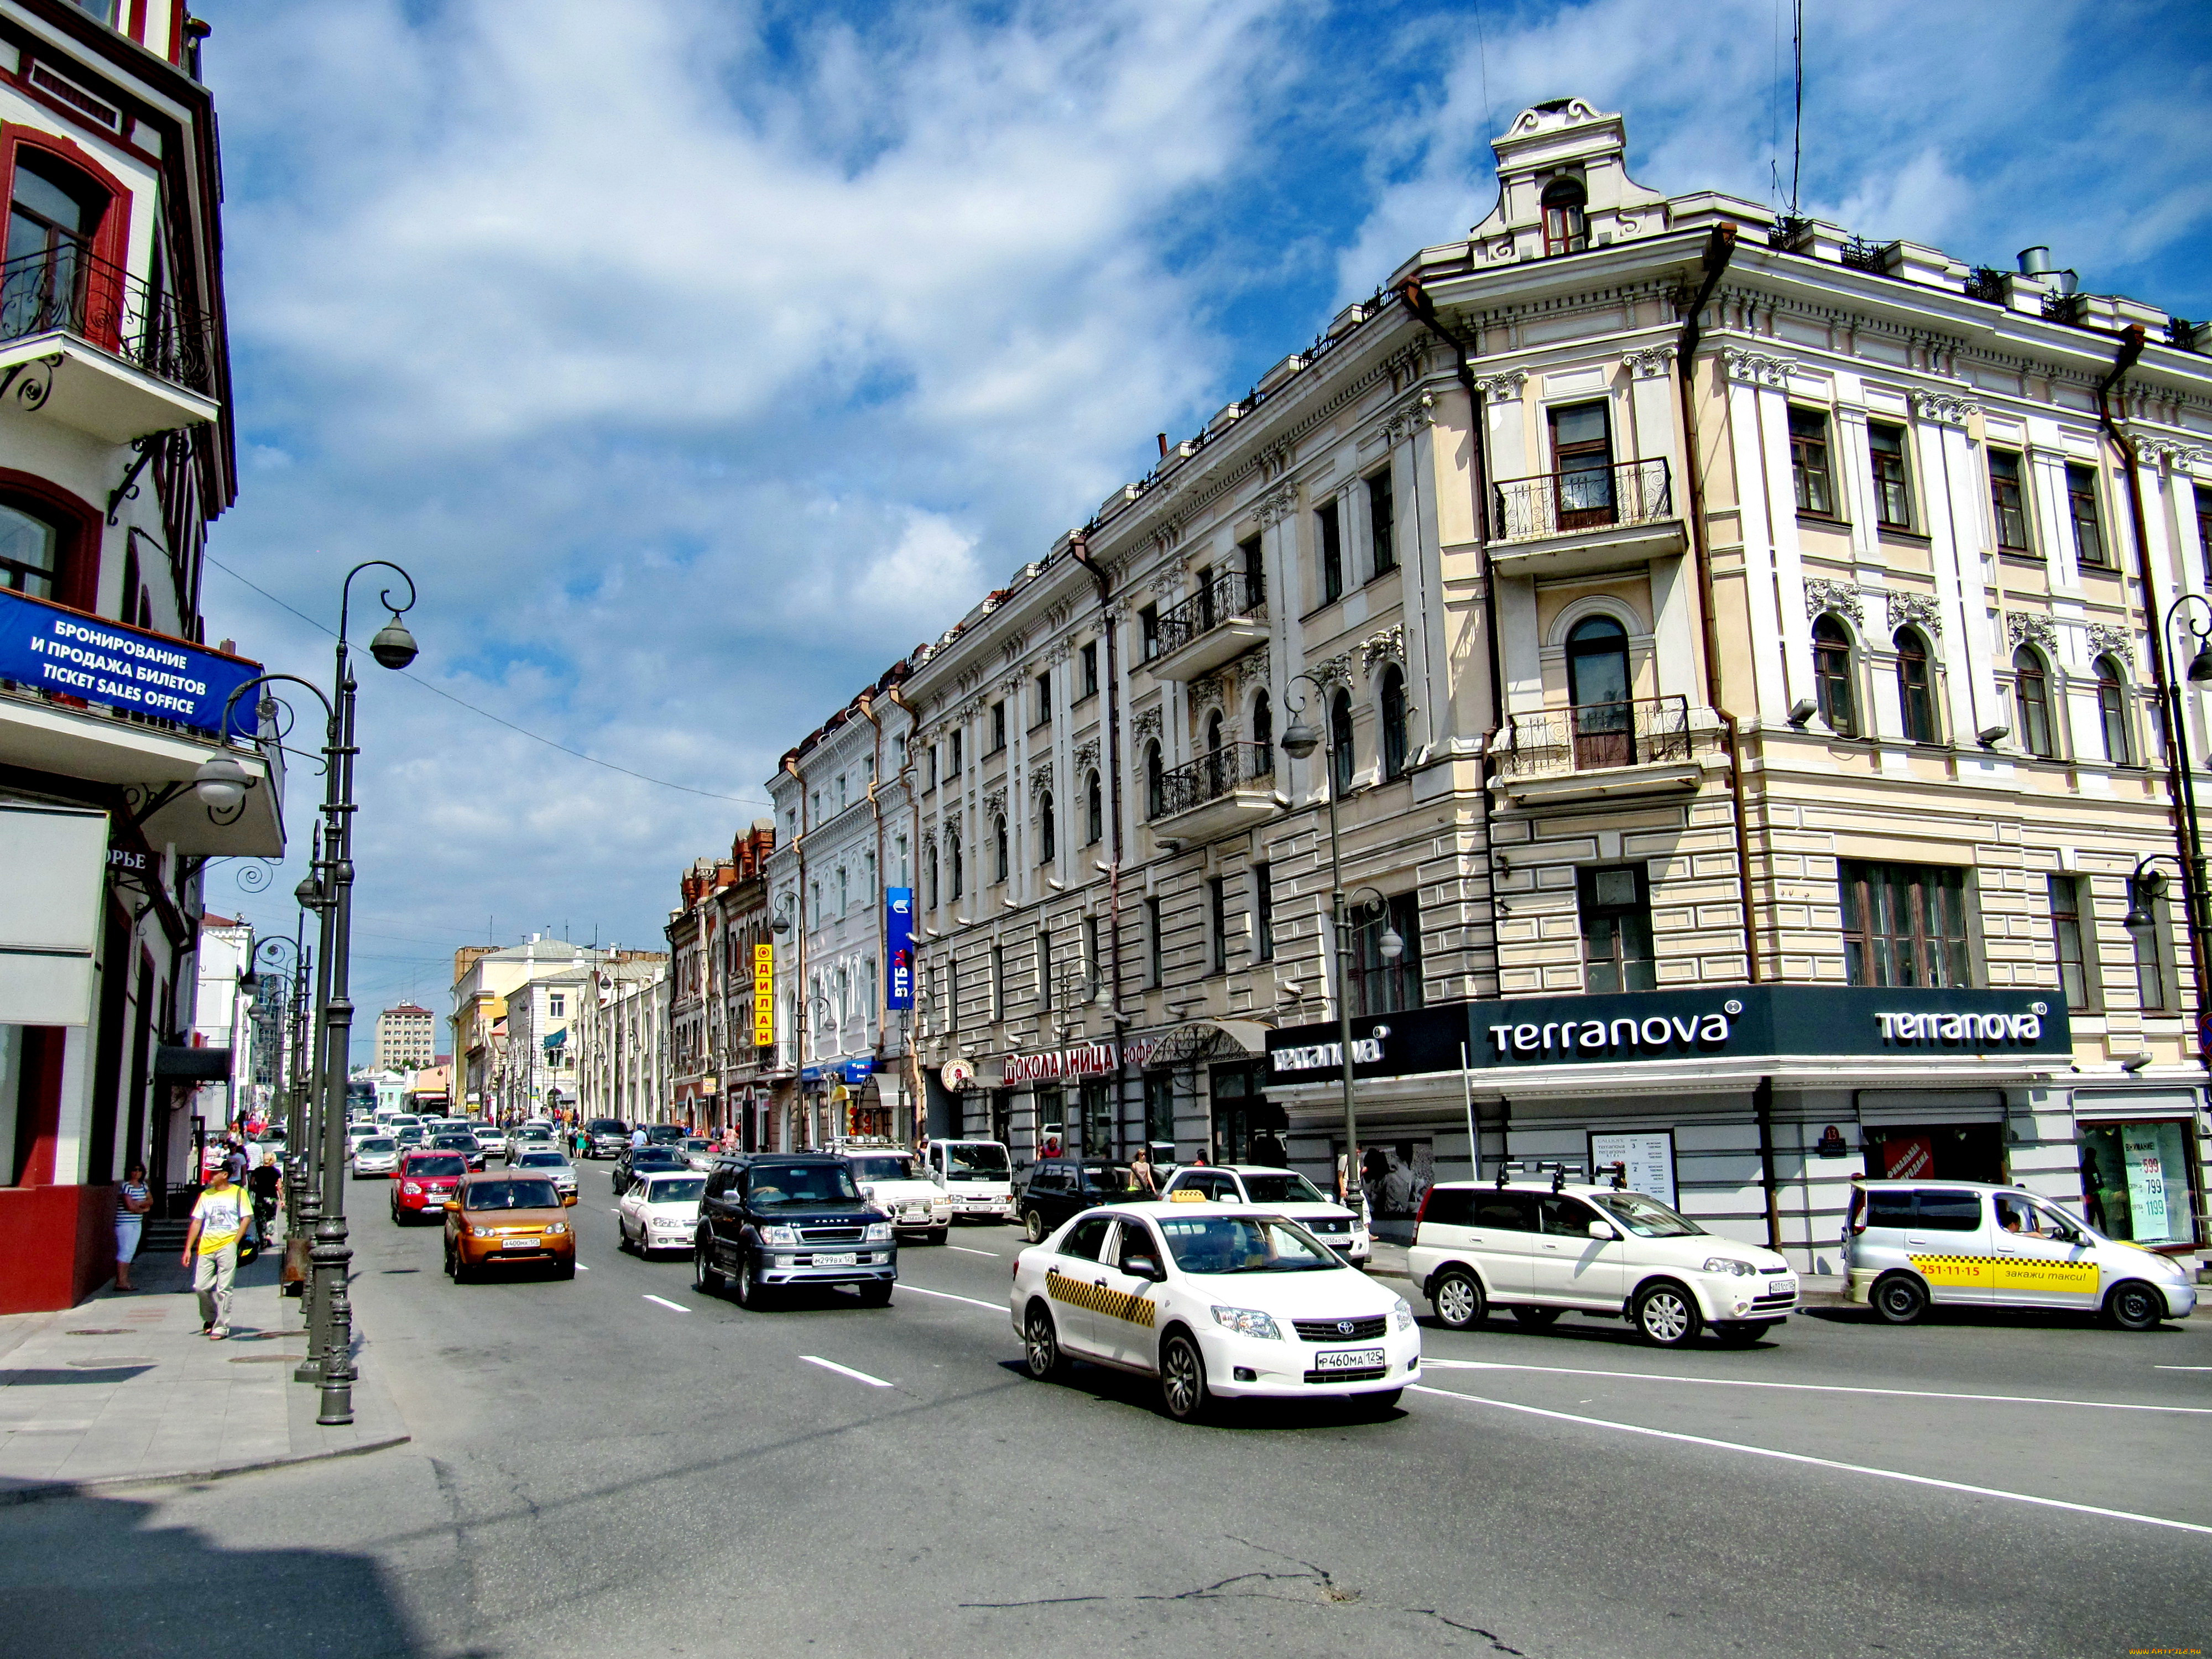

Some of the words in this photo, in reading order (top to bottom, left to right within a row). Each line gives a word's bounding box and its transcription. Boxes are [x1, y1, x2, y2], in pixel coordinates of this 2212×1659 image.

[55, 620, 187, 670] БРОНИРОВАНИЕ
[30, 636, 45, 653] И
[47, 641, 133, 678] ПРОДАЖА
[135, 665, 207, 696] БИЛЕТОВ
[43, 662, 96, 690] TICKET
[96, 678, 142, 702] SALES
[144, 690, 195, 715] OFFICE
[1827, 1129, 1837, 1140] 13
[2142, 1158, 2159, 1173] 599
[2145, 1178, 2162, 1194] 799
[2146, 1199, 2164, 1216] 1199
[2005, 1270, 2044, 1279] закажи
[2048, 1272, 2086, 1282] такси!
[1365, 1351, 1381, 1362] 125
